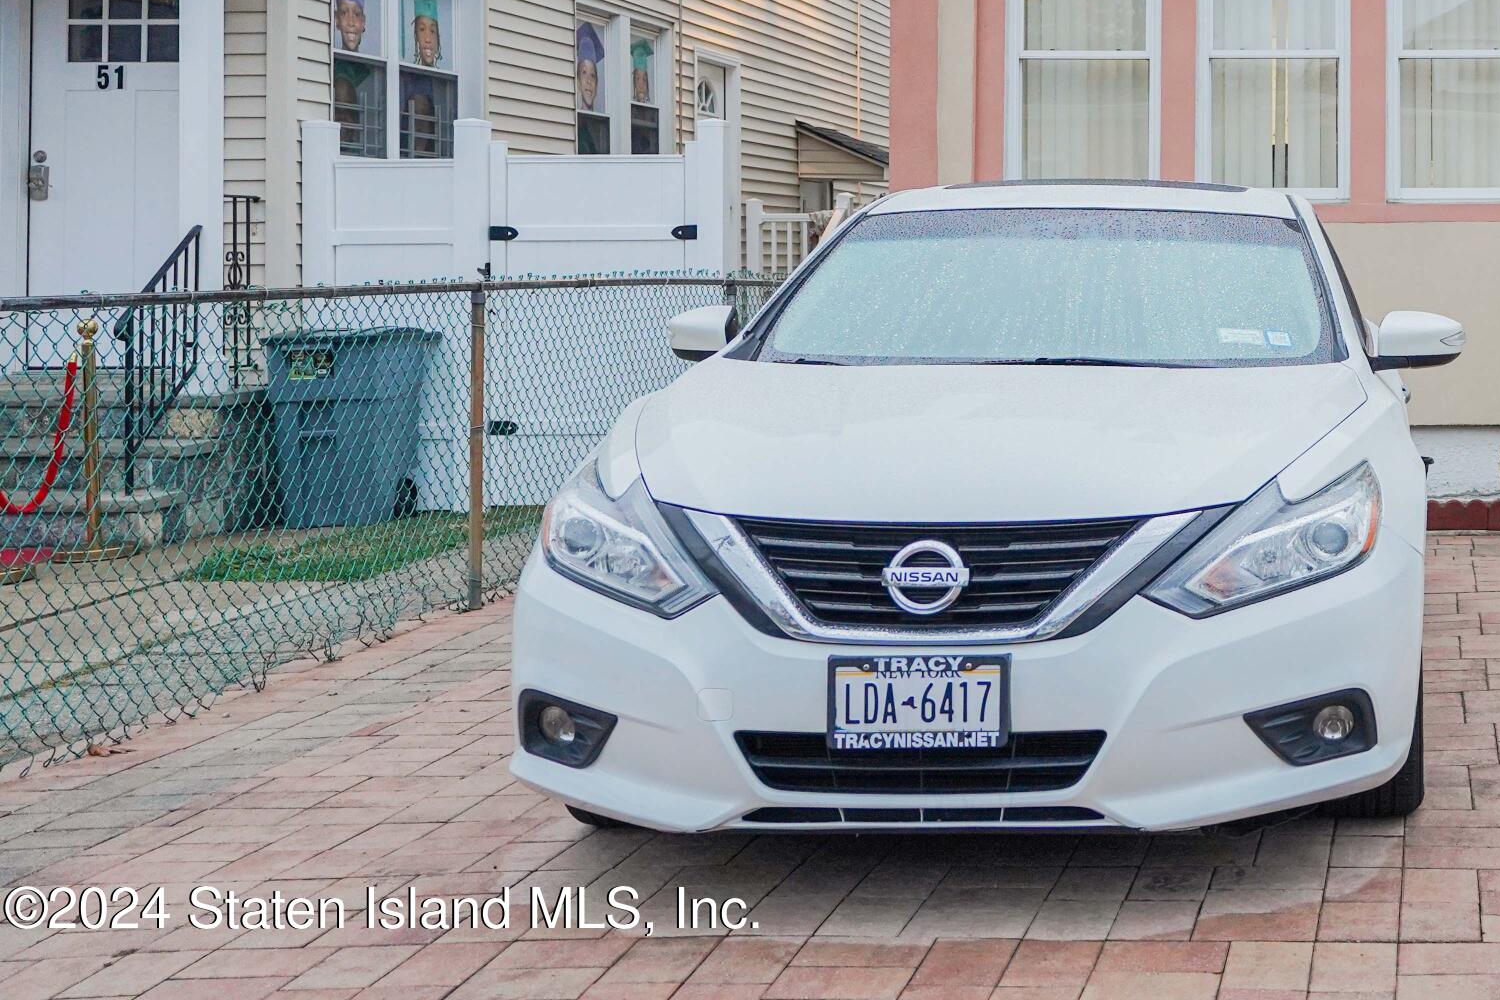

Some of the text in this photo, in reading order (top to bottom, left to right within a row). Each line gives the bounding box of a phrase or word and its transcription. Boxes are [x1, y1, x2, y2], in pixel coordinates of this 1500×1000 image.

[97, 64, 124, 90] 51
[890, 571, 959, 583] NISSAN
[873, 656, 964, 672] TRACY
[833, 731, 1000, 750] TRACYNISSAN.NET
